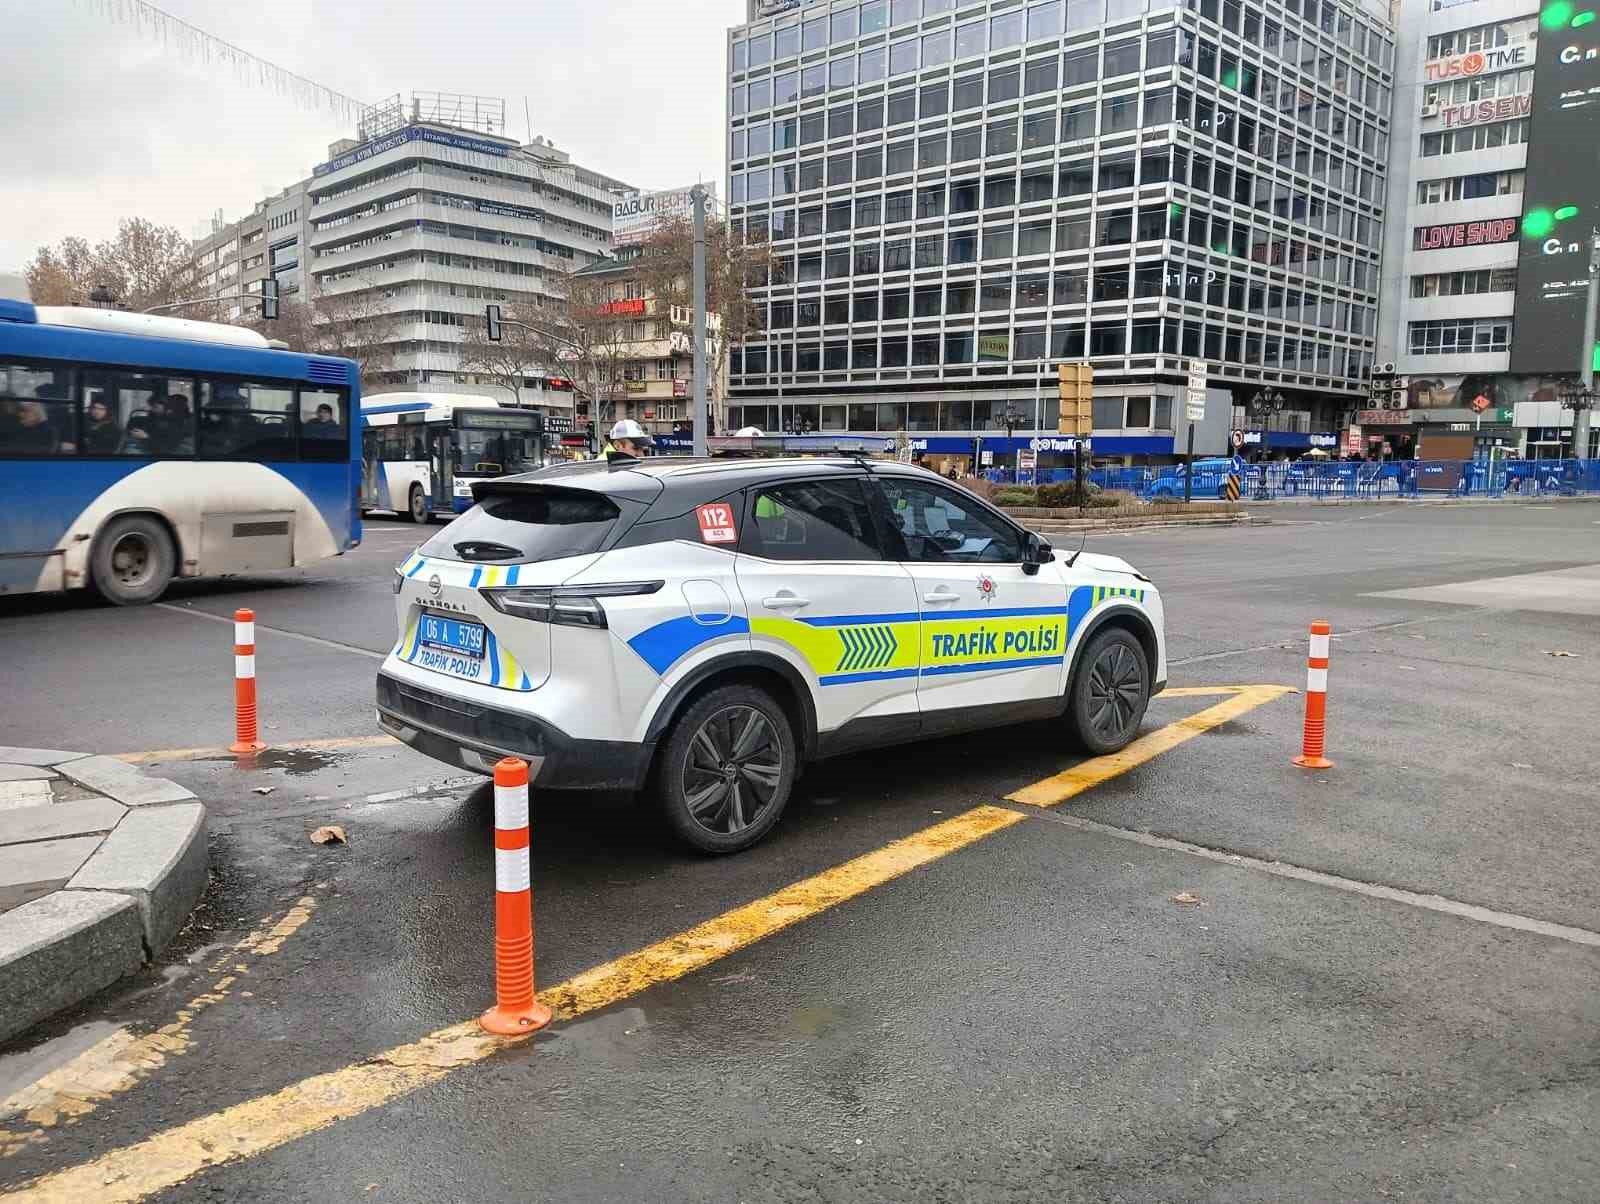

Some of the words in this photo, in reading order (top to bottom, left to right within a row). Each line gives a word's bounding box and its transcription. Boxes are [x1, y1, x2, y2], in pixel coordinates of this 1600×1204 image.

[1425, 60, 1460, 80] TUS
[1486, 46, 1526, 69] TIME
[1421, 223, 1465, 249] LOVE
[1466, 218, 1516, 244] SHOP
[702, 508, 729, 527] 112
[415, 597, 467, 612] QASHQAI
[426, 619, 438, 640] 06
[442, 624, 449, 642] A
[459, 625, 483, 650] 5799
[932, 626, 998, 657] TRAFİK
[1003, 624, 1059, 653] POLİSİ
[420, 650, 449, 670] TRAFİK
[449, 657, 481, 678] POLİSİ
